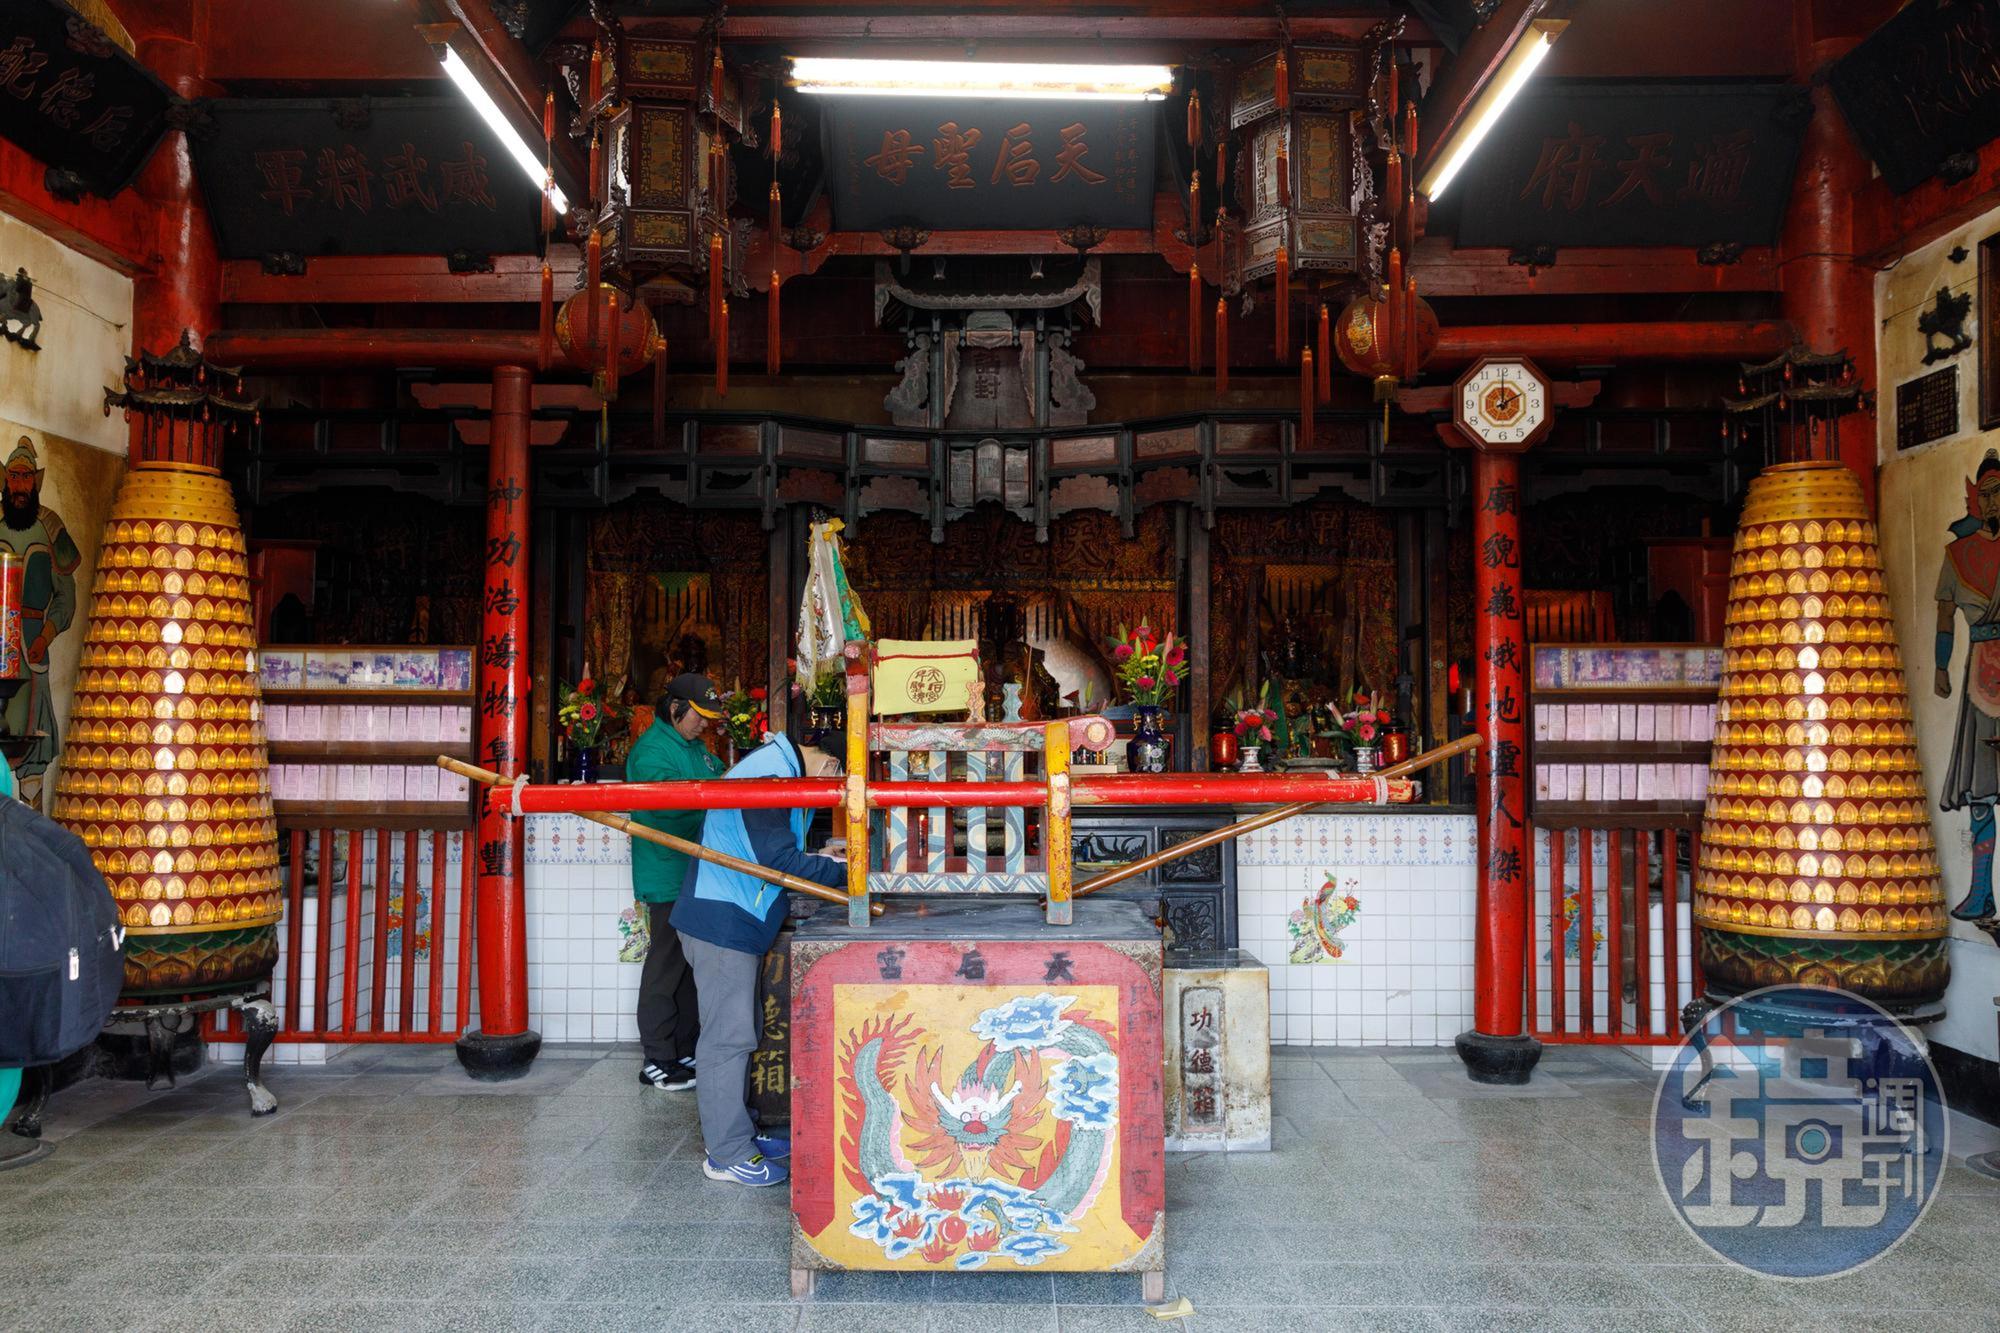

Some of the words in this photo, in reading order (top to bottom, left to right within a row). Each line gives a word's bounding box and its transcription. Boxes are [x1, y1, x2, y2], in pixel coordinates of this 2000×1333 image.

[864, 120, 1110, 190] 天后聖母
[254, 141, 497, 217] 威武將軍
[1480, 371, 1489, 380] 11
[1496, 368, 1508, 377] 12
[1517, 370, 1522, 379] 1
[1468, 383, 1480, 392] 10
[1528, 382, 1536, 391] 2
[1465, 399, 1474, 409] 9
[1531, 399, 1540, 408] 3
[1469, 416, 1478, 426] 8
[1527, 415, 1535, 424] 4
[1482, 428, 1490, 437] 7
[1498, 431, 1507, 440] 6
[1516, 428, 1524, 437] 5
[1481, 479, 1521, 883] 廟貌巍峨地靈人傑
[876, 946, 1077, 986] 天后宮
[1189, 1007, 1216, 1117] 功德箱
